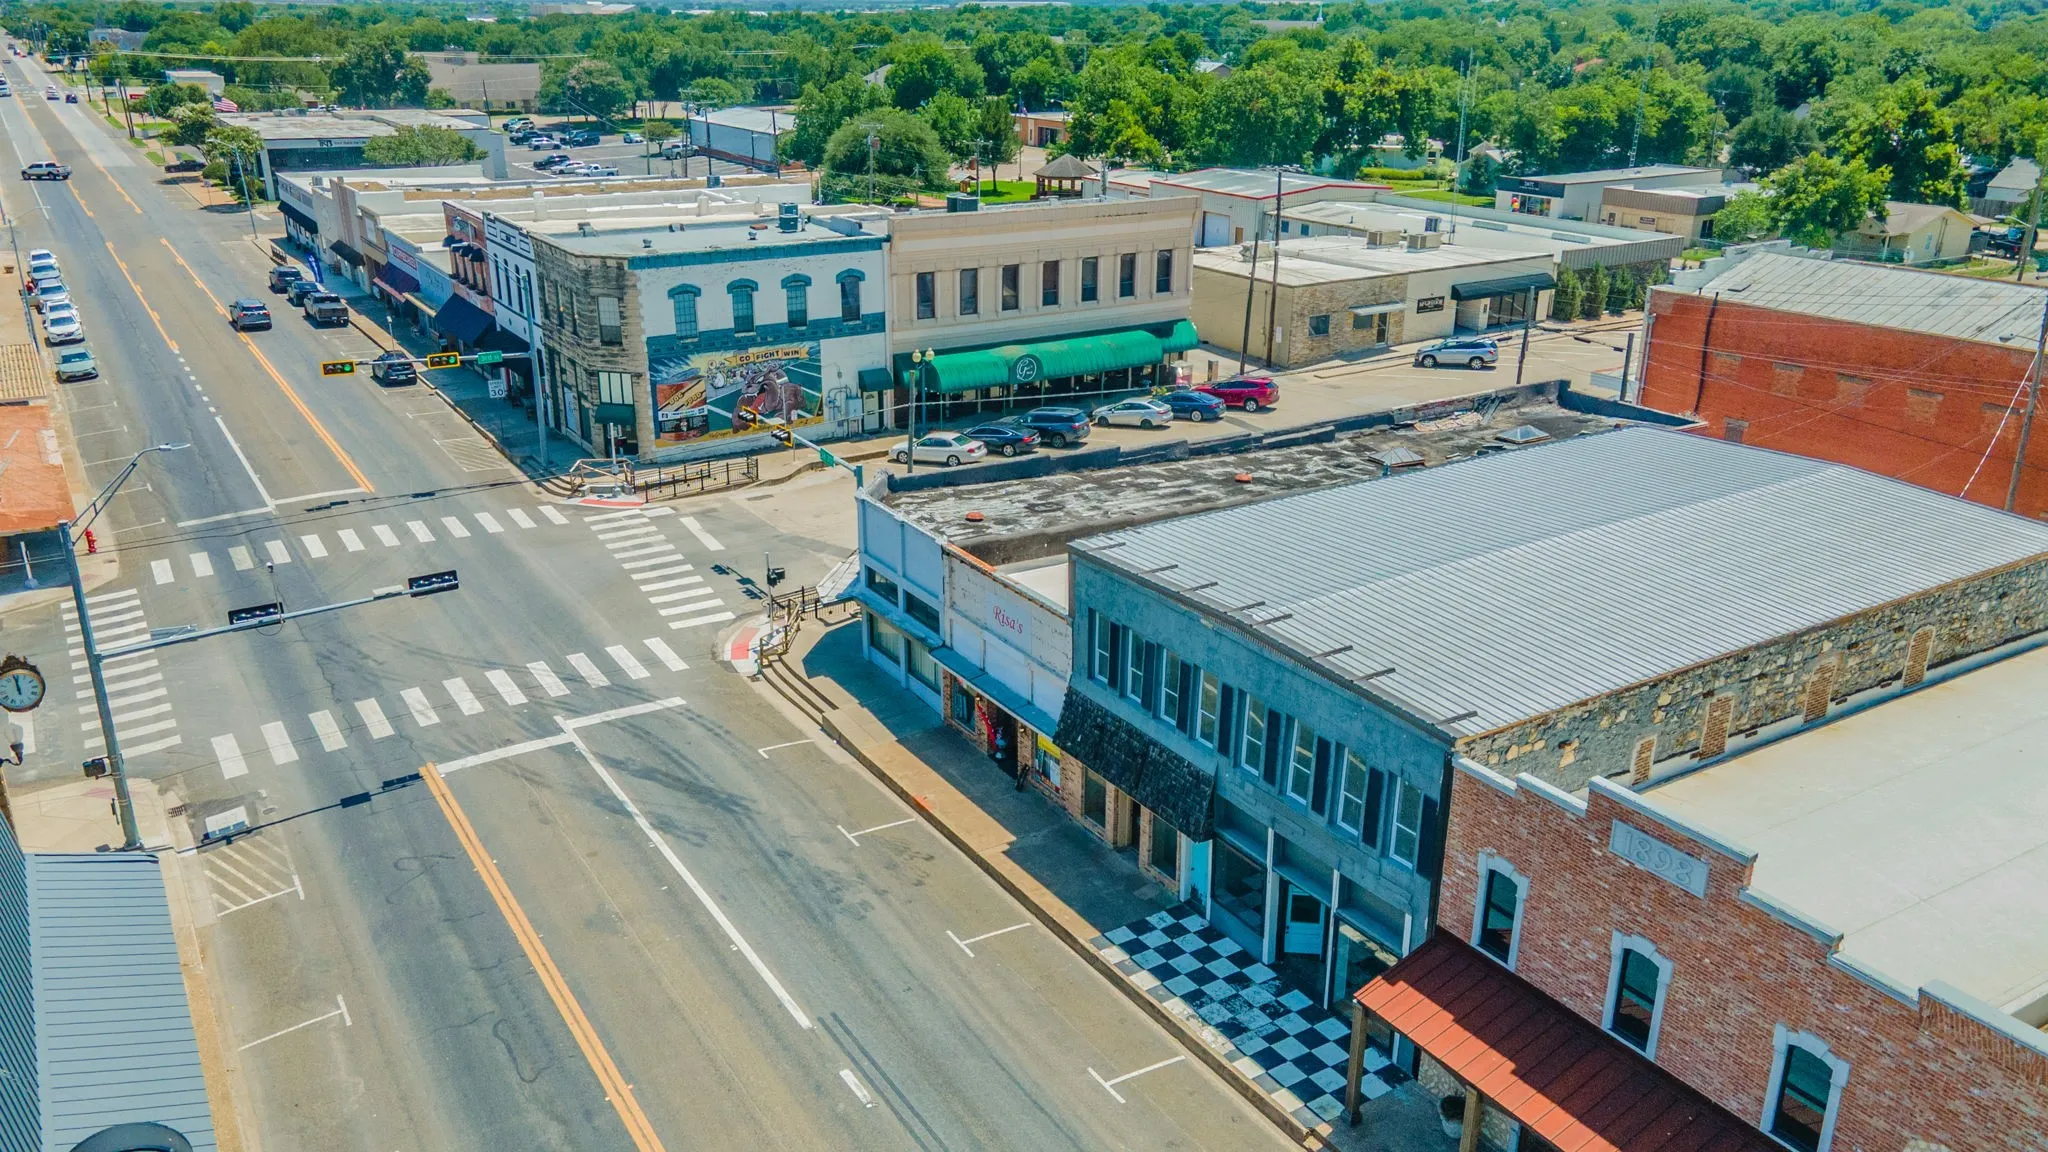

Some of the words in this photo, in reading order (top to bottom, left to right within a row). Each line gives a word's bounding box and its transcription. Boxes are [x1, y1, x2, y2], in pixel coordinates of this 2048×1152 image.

[756, 350, 779, 360] FIGHT
[783, 350, 800, 358] WIN
[491, 389, 503, 397] 30
[993, 605, 1023, 634] Risa's
[1623, 831, 1694, 886] 1898
